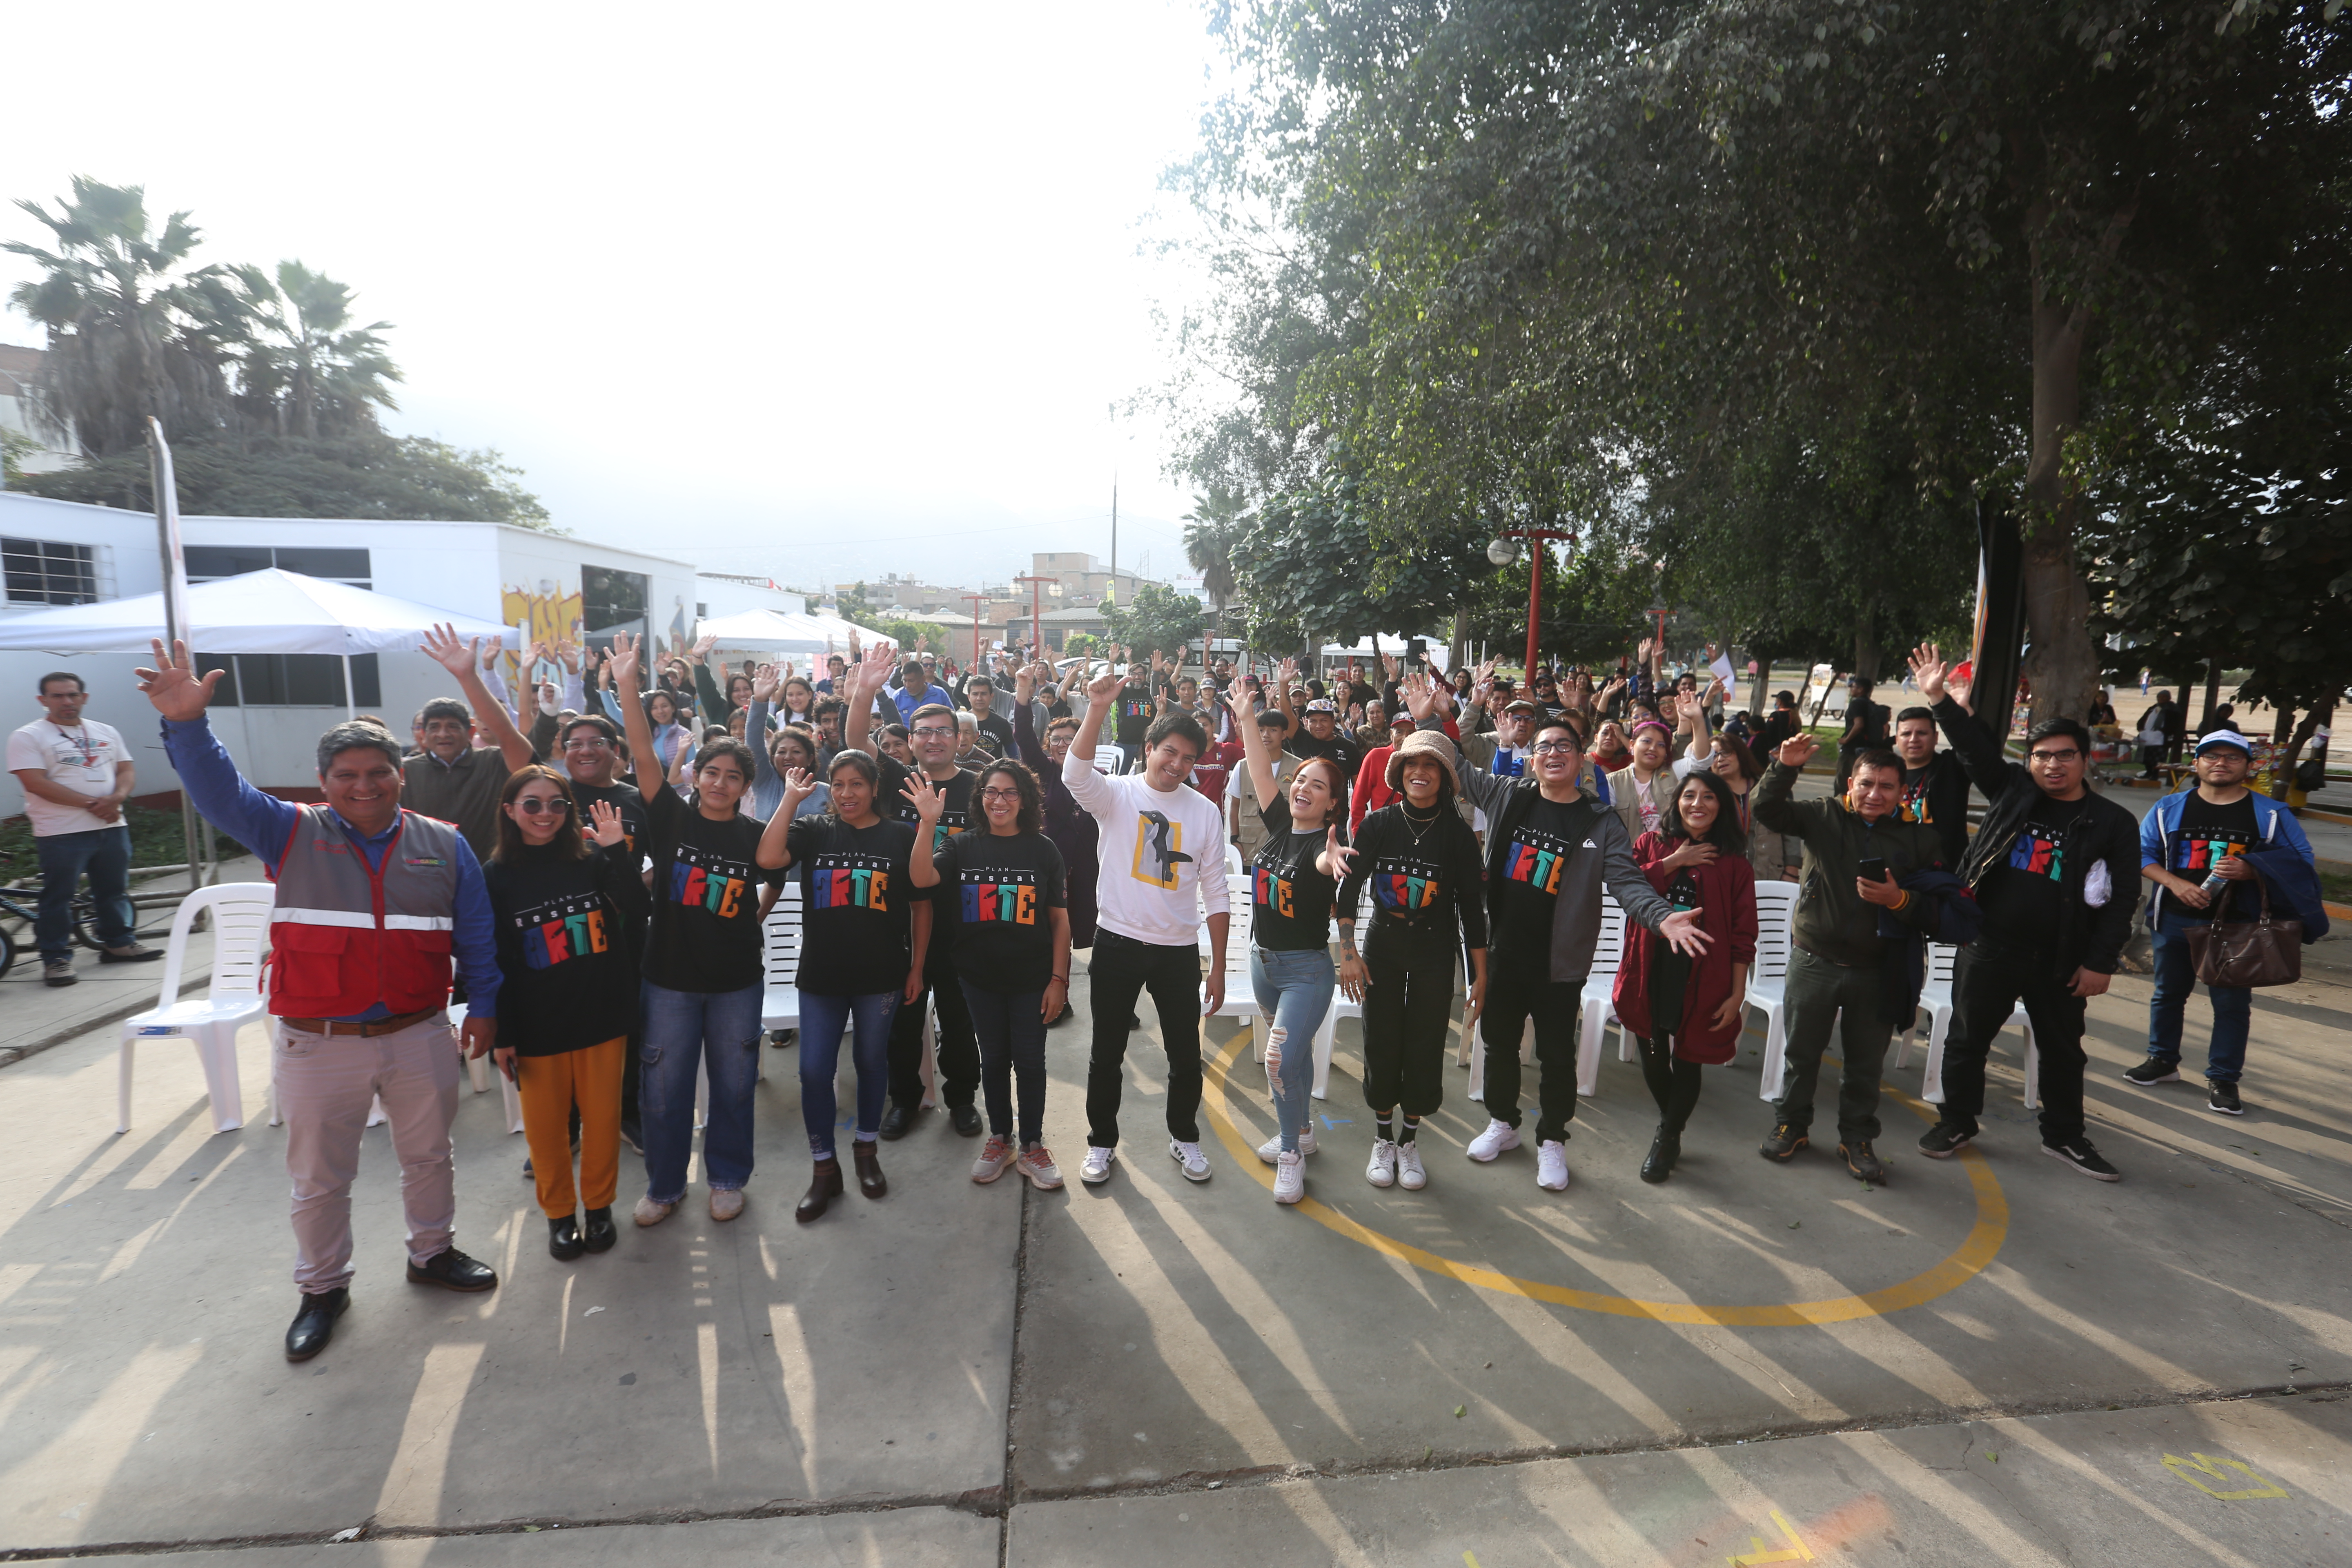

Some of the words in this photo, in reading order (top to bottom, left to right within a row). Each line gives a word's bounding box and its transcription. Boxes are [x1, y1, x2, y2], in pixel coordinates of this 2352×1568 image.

[1532, 829, 1554, 838] PLAN
[2185, 833, 2250, 842] escat
[676, 848, 748, 877] Recat
[815, 858, 891, 870] Rescat
[960, 872, 1035, 882] Rescat
[1376, 861, 1442, 878] Resca
[1502, 841, 1564, 895] ARTE
[544, 895, 572, 906] PLAN
[669, 861, 746, 918] ARTE
[813, 869, 889, 912] ARTE
[960, 884, 1036, 925] ARTE
[1375, 873, 1440, 910] ARTE
[515, 896, 601, 927] Rescat
[522, 909, 608, 970] ARTE
